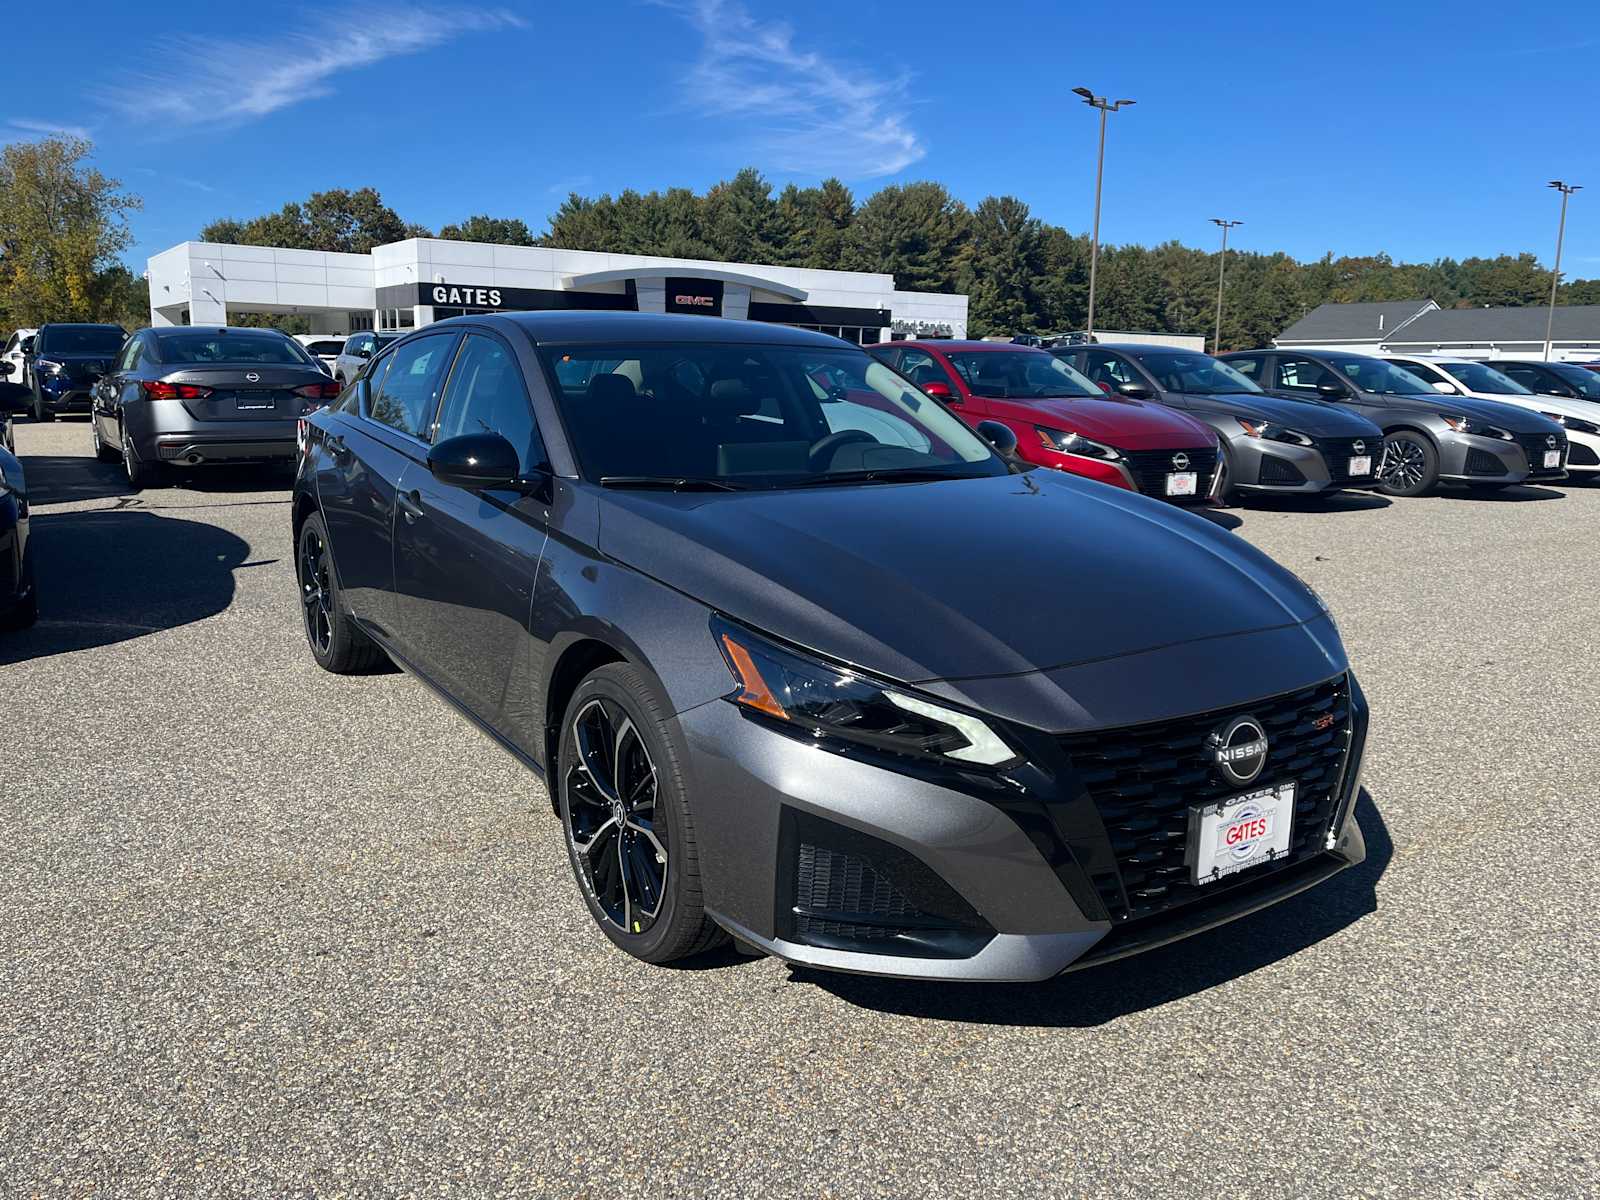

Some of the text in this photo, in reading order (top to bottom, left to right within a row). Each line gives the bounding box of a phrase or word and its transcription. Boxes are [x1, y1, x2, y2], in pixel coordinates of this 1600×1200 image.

[433, 286, 502, 306] GATES
[675, 295, 714, 306] GMC
[891, 319, 916, 331] tified
[1218, 741, 1268, 761] NISSAN
[1225, 782, 1296, 805] GATES GMC
[1226, 818, 1266, 845] GATES
